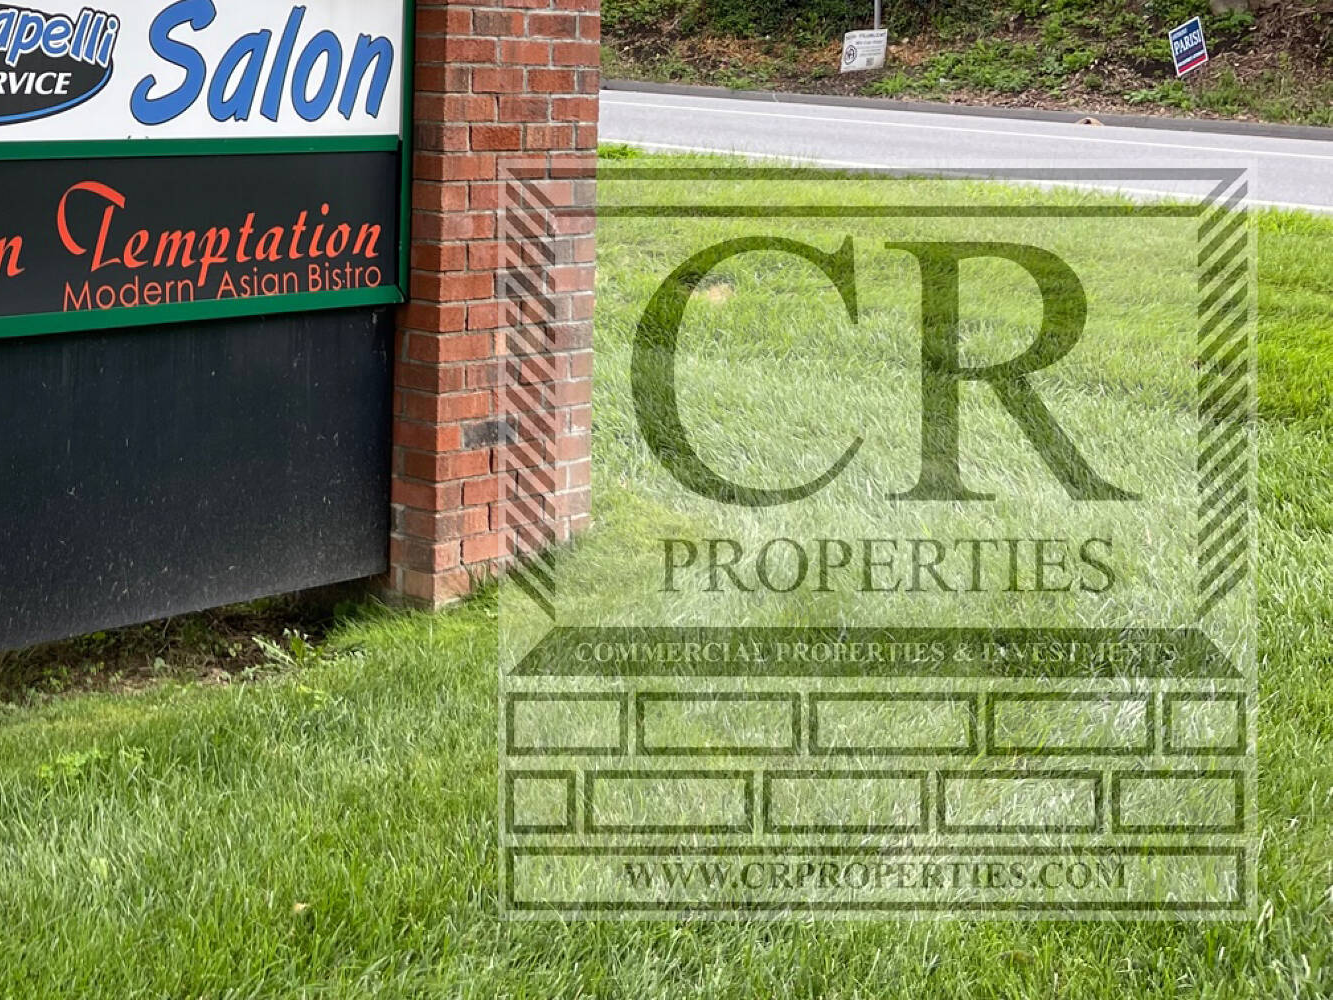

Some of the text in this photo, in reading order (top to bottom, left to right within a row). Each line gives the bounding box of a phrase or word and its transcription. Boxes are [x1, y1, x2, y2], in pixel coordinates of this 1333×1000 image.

[56, 180, 383, 287] Temptation
[63, 261, 382, 312] Modern Asian Bistro
